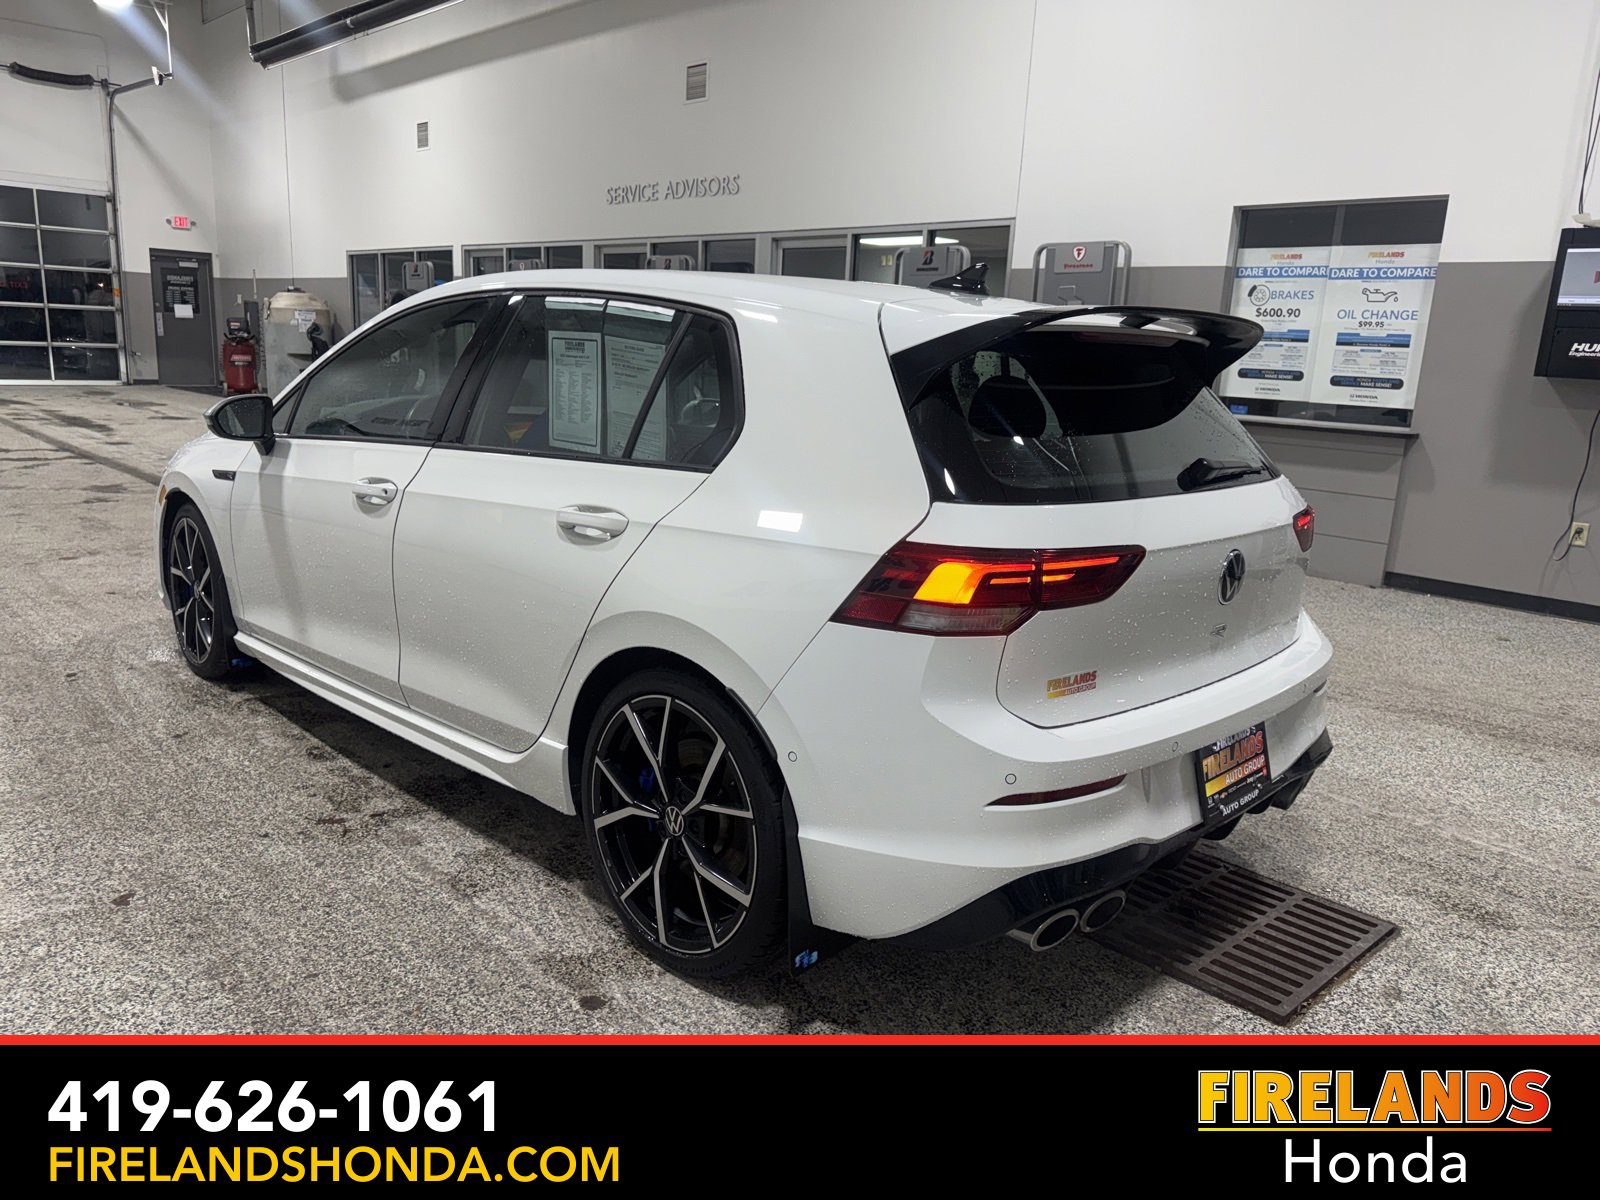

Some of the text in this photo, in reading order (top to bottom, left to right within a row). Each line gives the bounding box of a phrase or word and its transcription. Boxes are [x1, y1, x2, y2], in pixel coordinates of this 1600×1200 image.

[606, 173, 740, 205] SERVICE ADVISORS
[174, 216, 188, 227] EXIT
[1238, 267, 1264, 276] DARE
[1266, 267, 1280, 276] TO
[1331, 267, 1437, 278] DARE TO COMPARE
[1271, 290, 1315, 300] BRAKES
[1255, 307, 1301, 318] $600.90
[1337, 309, 1419, 320] OIL CHANGE
[1358, 320, 1385, 328] $99.95
[1047, 670, 1097, 692] FIRELANDS
[1064, 682, 1096, 695] AUTO GROUP
[1202, 730, 1265, 781] FIRELANDS
[1225, 767, 1242, 785] AUTO
[1244, 754, 1265, 775] GROUP
[1222, 800, 1239, 816] AUTO
[1240, 788, 1260, 806] GROUP
